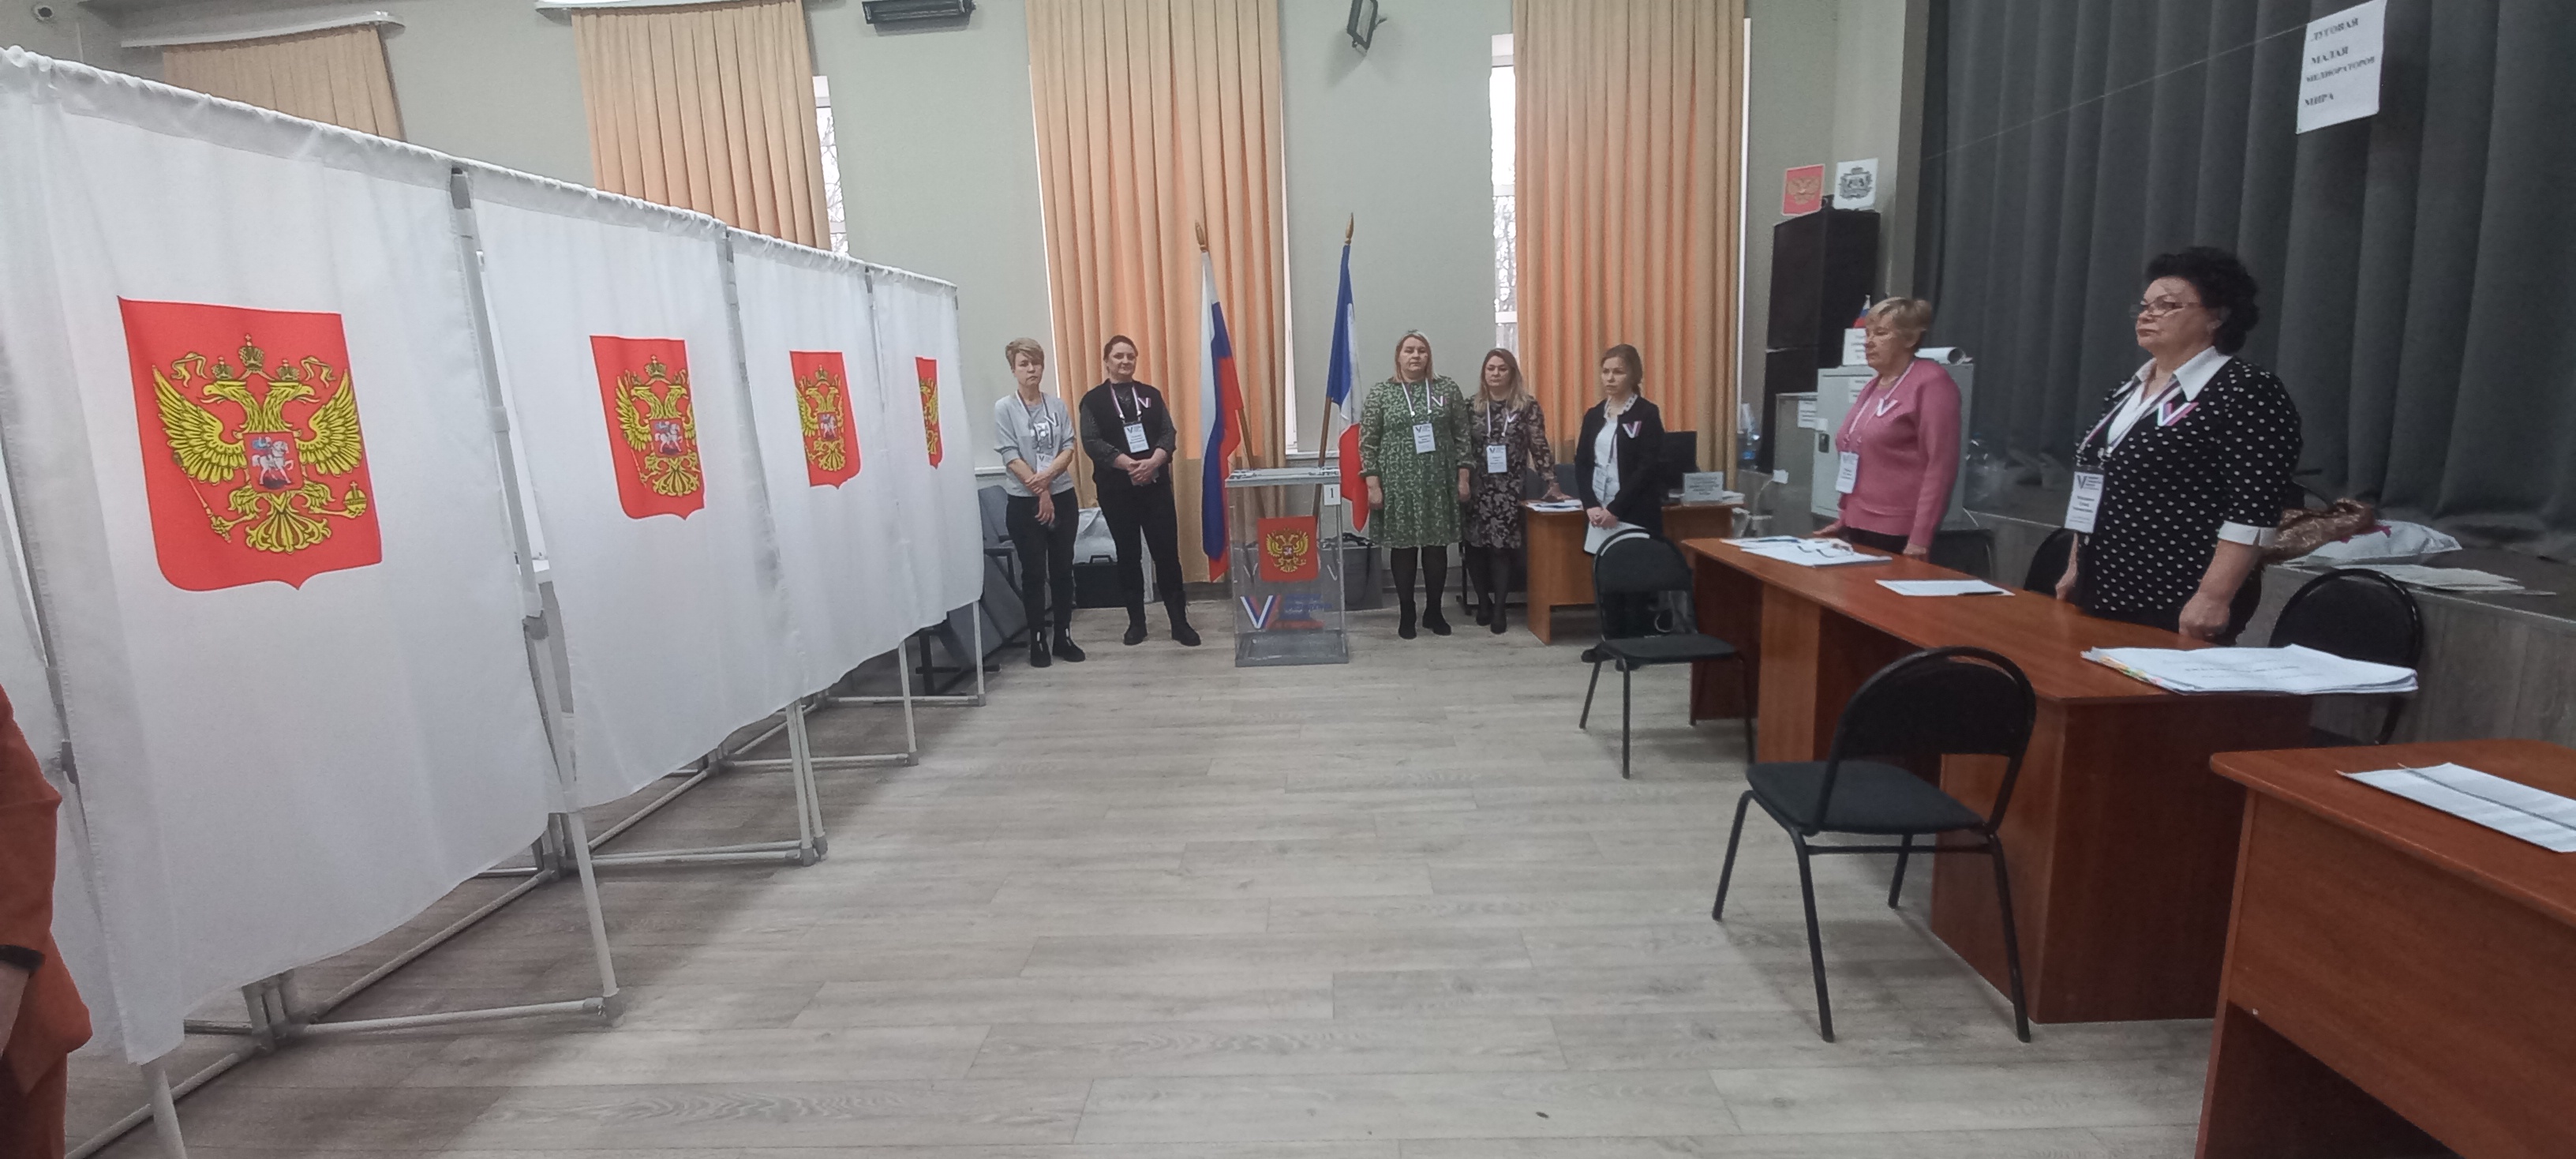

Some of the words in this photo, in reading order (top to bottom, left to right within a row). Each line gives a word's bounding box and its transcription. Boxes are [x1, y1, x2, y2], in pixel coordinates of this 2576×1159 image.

[2311, 46, 2349, 64] МАЛАЯ
[2305, 92, 2334, 106] МИРА
[1330, 487, 1335, 498] 1
